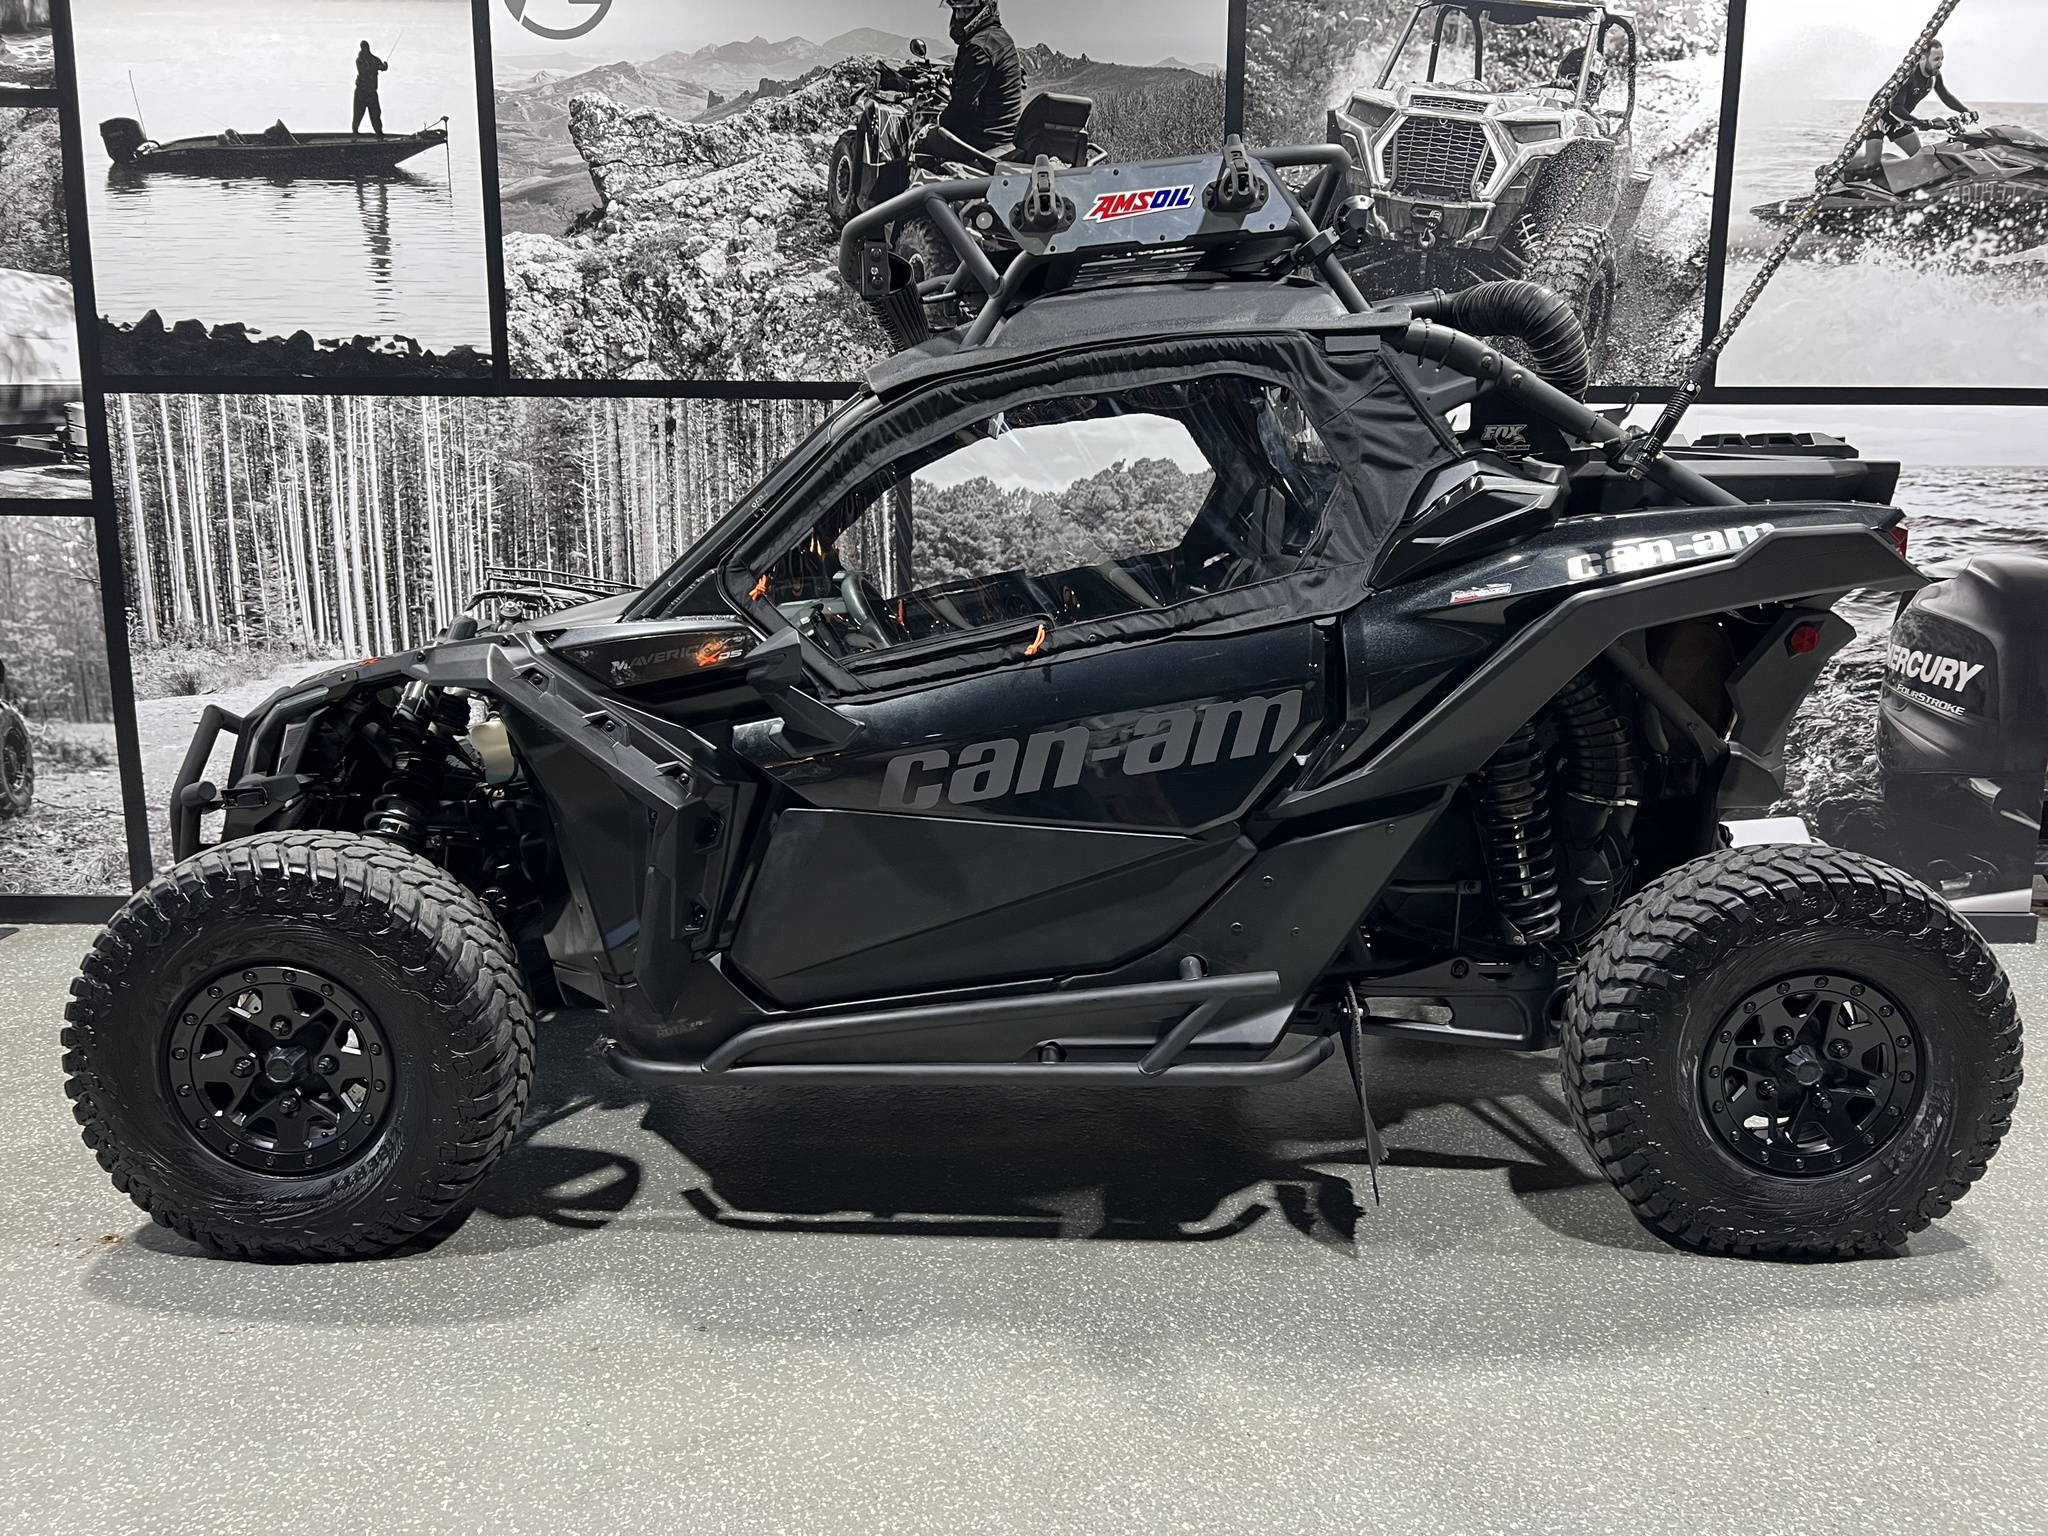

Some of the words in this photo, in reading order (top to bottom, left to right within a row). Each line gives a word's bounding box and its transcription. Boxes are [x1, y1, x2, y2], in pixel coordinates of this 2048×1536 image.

[1089, 187, 1191, 220] AMSOIL
[1482, 425, 1526, 440] FOX
[1567, 523, 1775, 581] can-am
[610, 644, 702, 674] MAVERIC
[1886, 643, 1985, 693] MERCURY
[877, 689, 1303, 810] can-am
